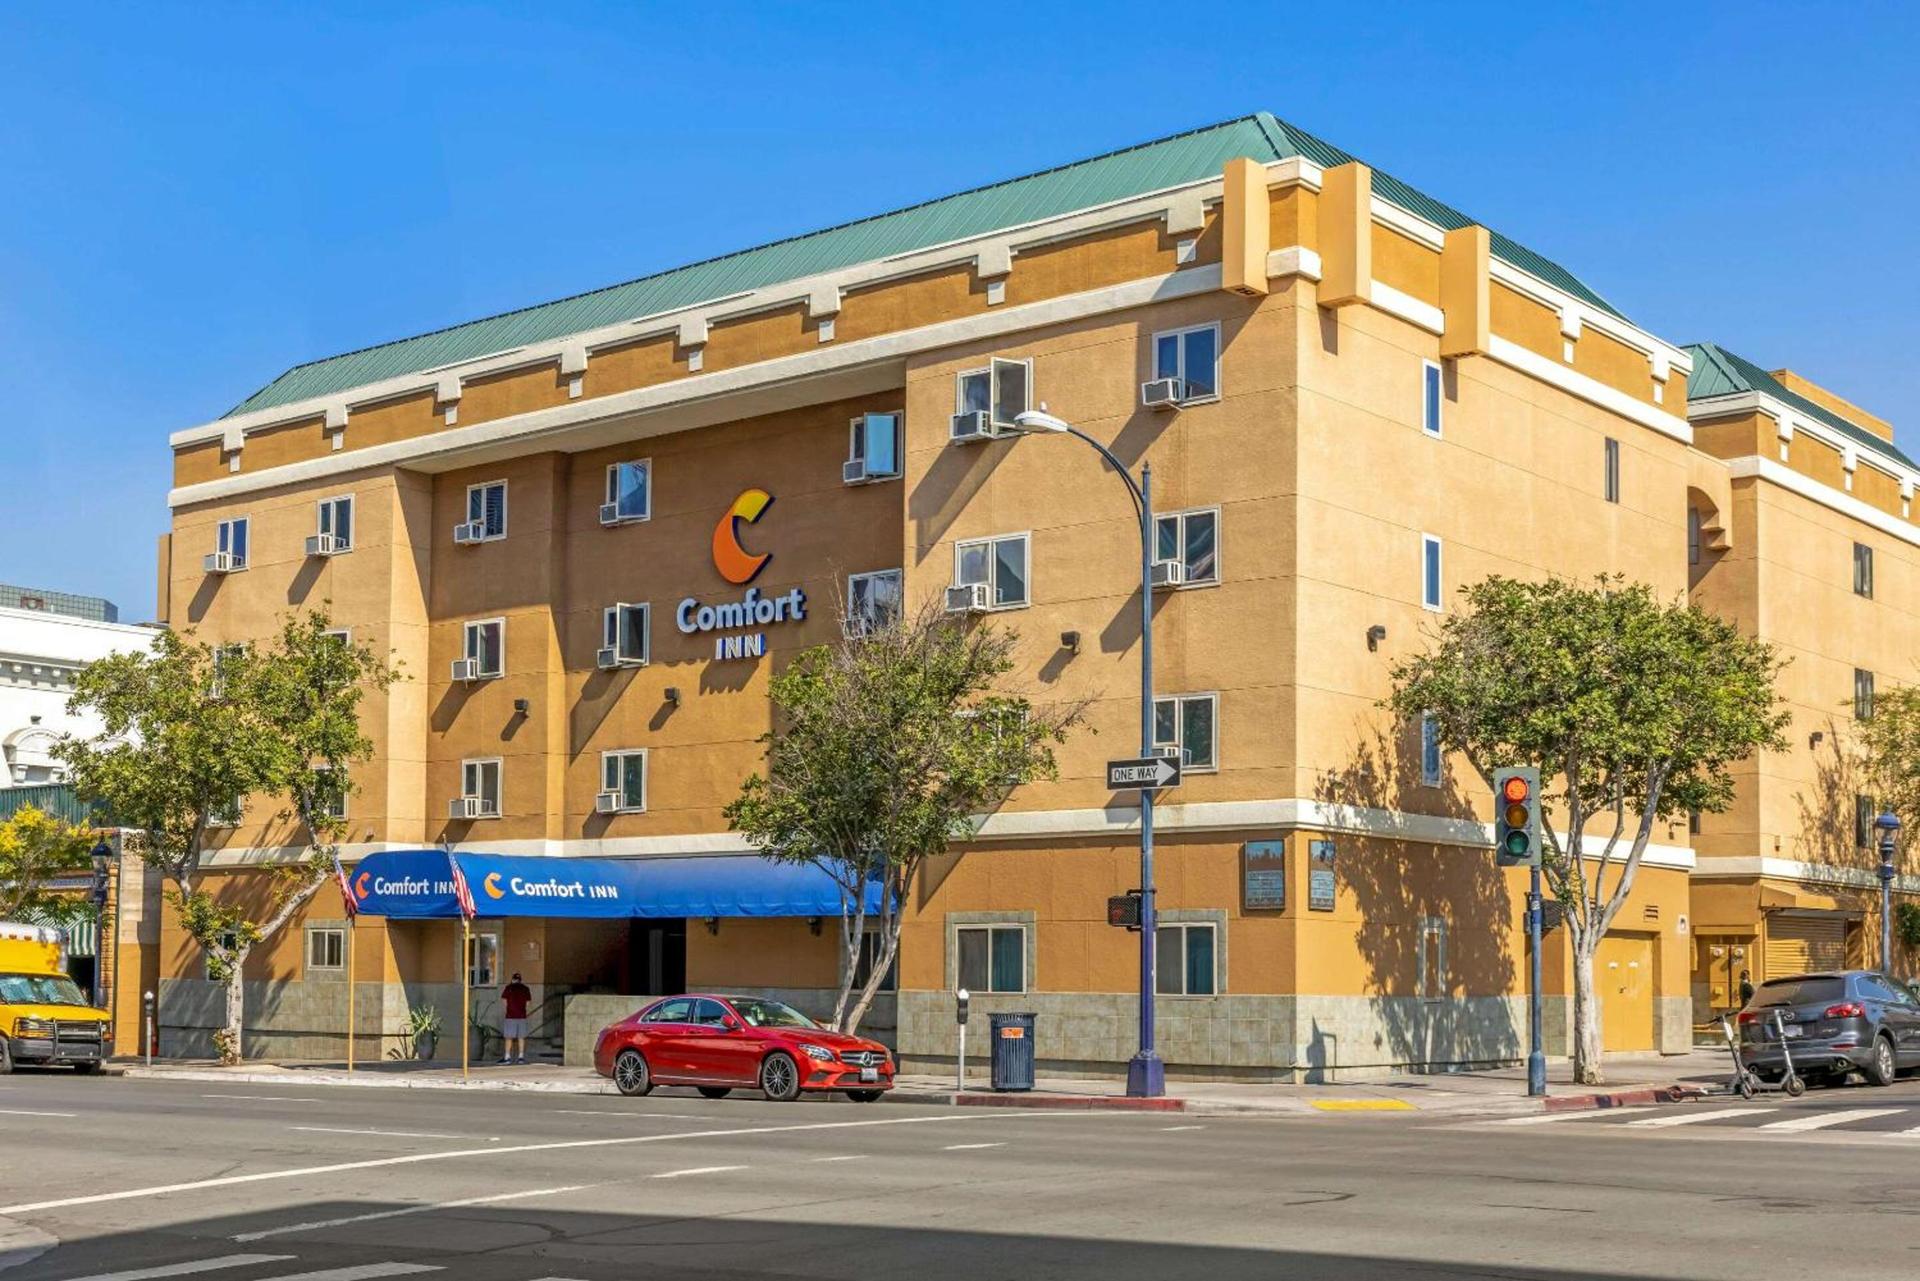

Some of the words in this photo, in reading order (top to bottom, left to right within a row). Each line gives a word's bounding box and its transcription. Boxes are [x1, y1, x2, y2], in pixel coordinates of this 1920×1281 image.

[677, 588, 807, 634] Comfort
[715, 634, 766, 660] INN
[1114, 768, 1134, 781] ONE
[1137, 767, 1158, 779] WAY
[374, 876, 430, 895] Comfort
[510, 877, 584, 898] Comfort
[589, 885, 618, 898] INN
